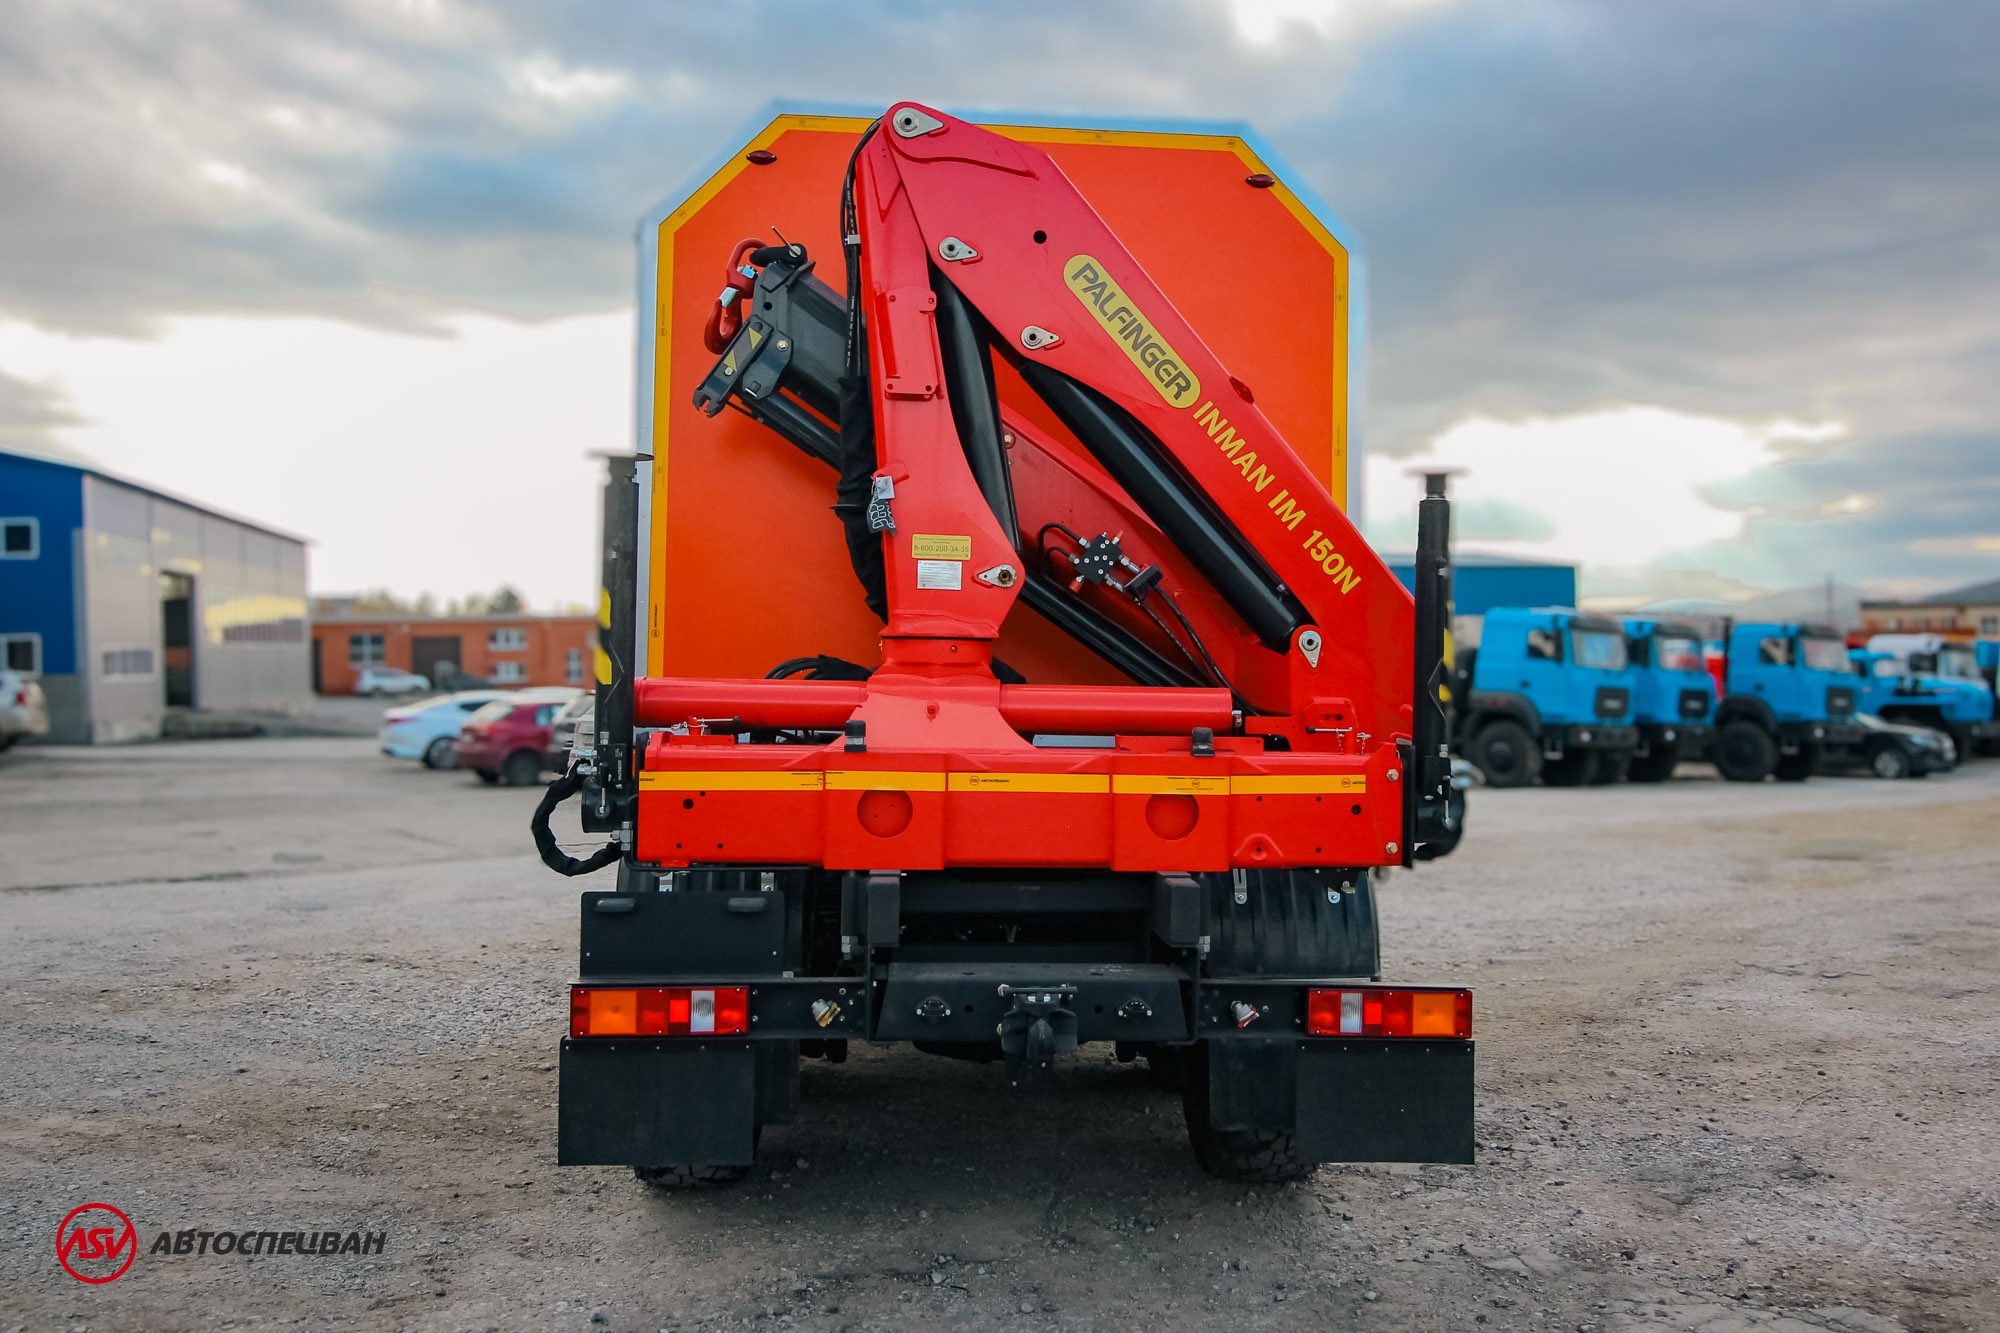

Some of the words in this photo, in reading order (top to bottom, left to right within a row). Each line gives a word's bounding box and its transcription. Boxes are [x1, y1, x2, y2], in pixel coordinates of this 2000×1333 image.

[1071, 262, 1192, 401] PALFINGER
[1192, 400, 1276, 493] INMAN
[1267, 489, 1307, 531] IM
[1302, 529, 1362, 595] 150N
